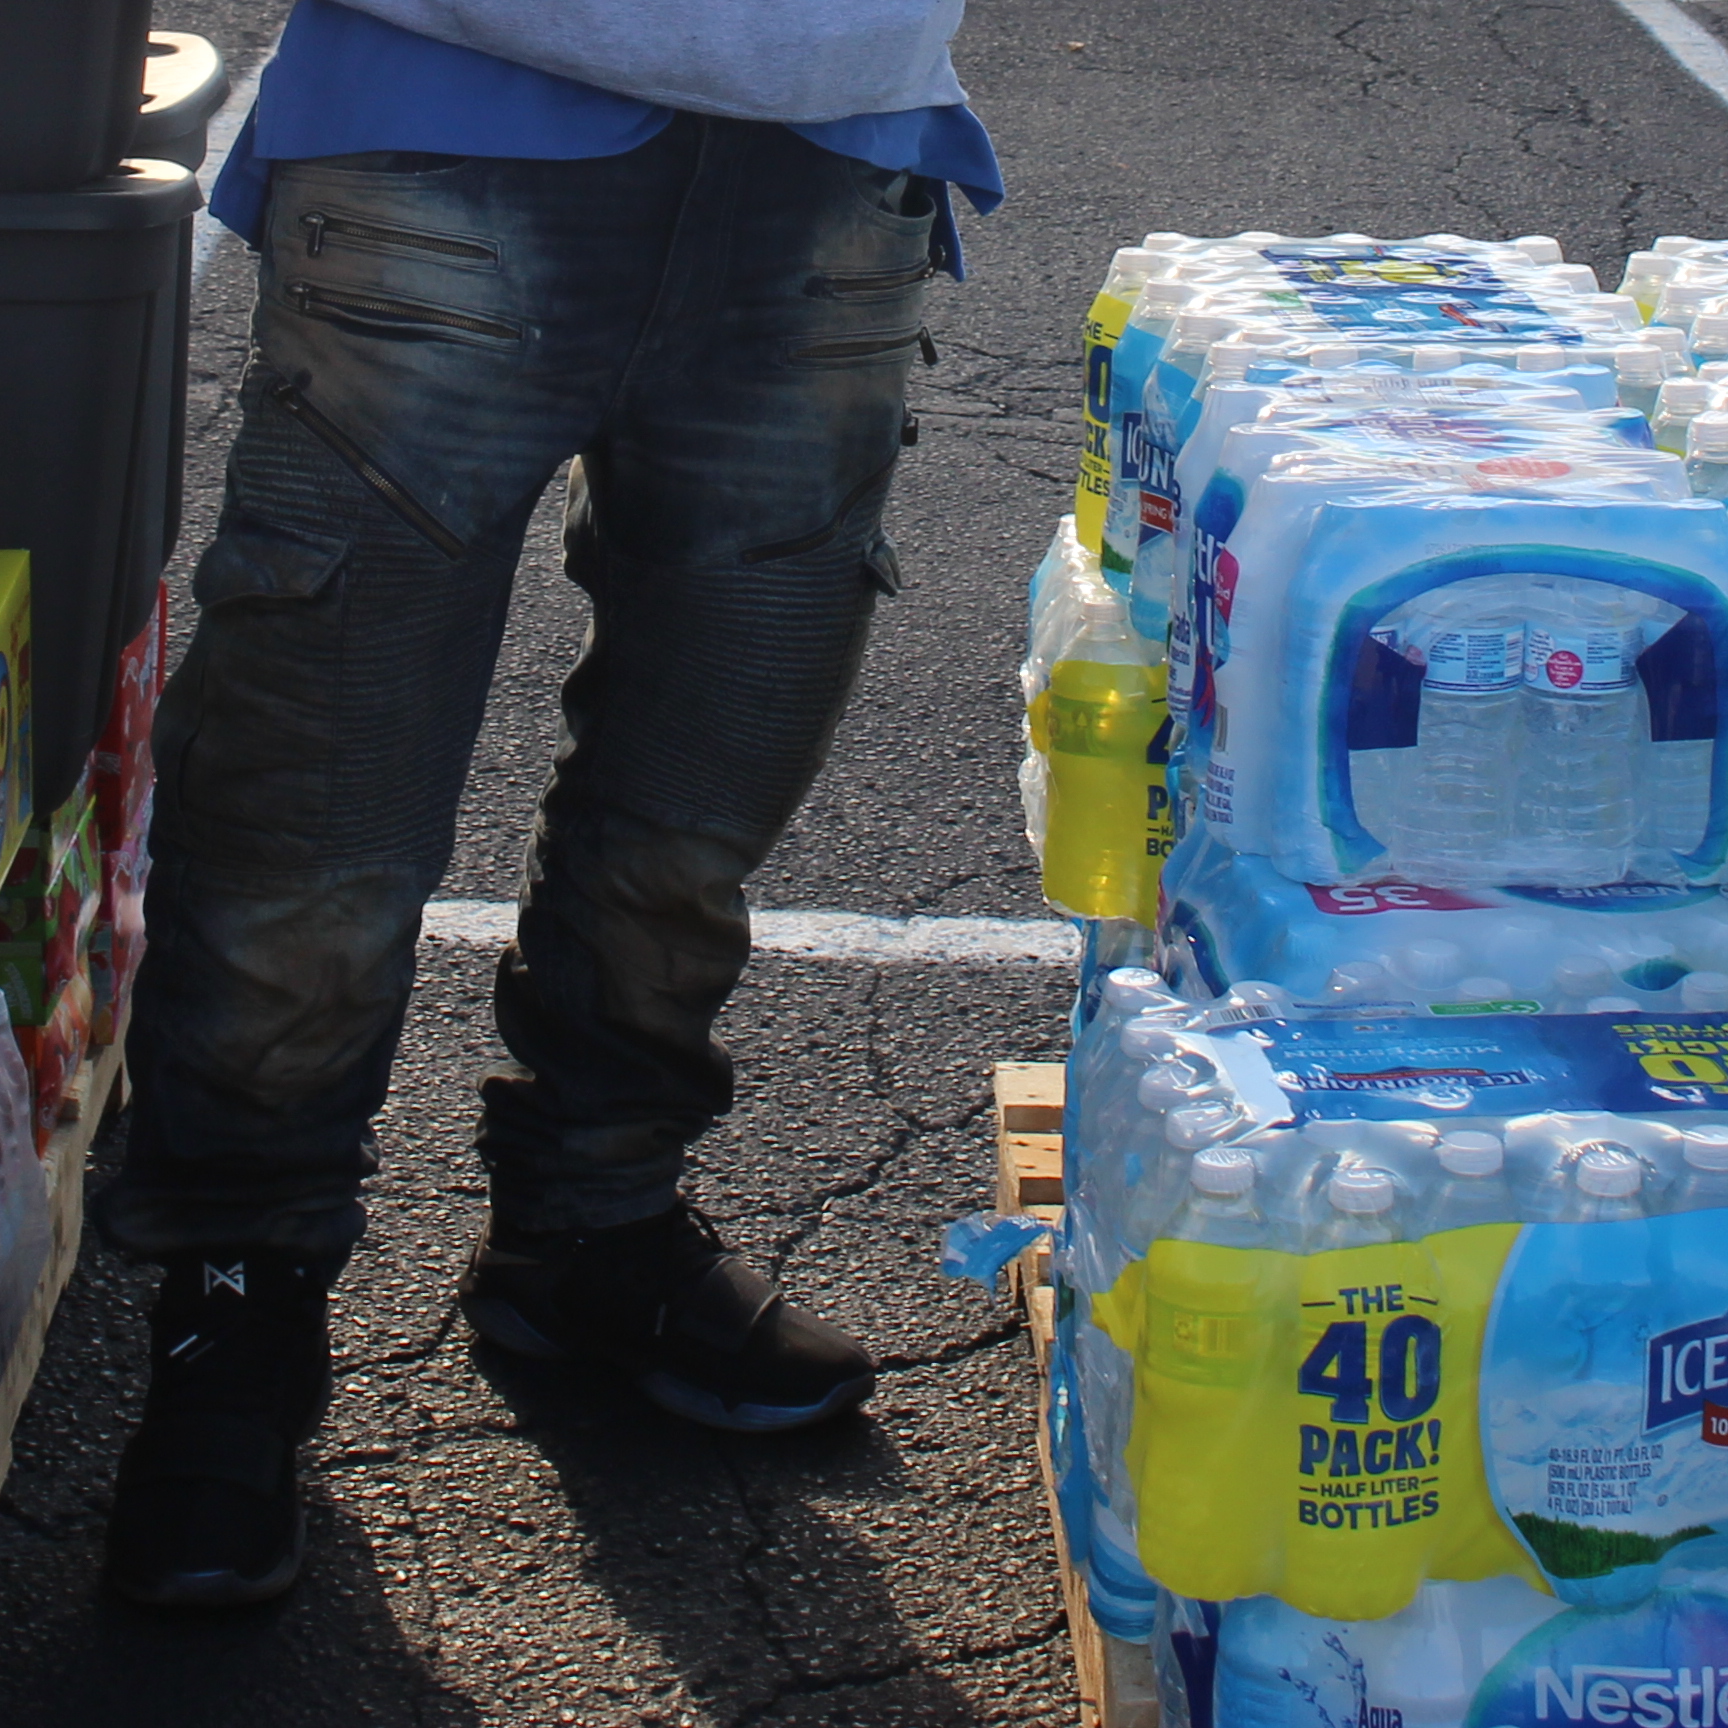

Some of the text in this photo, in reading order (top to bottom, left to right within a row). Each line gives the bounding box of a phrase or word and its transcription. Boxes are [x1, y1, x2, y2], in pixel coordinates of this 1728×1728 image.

[1330, 884, 1433, 911] 35
[1282, 1044, 1501, 1060] MIDWESTERN
[1477, 1072, 1522, 1087] ICE
[1339, 1283, 1406, 1315] THE
[1297, 1313, 1442, 1426] 40
[1298, 1423, 1442, 1476] PACK!
[1320, 1473, 1420, 1497] HALF LITER
[1298, 1491, 1440, 1531] BOTTLES
